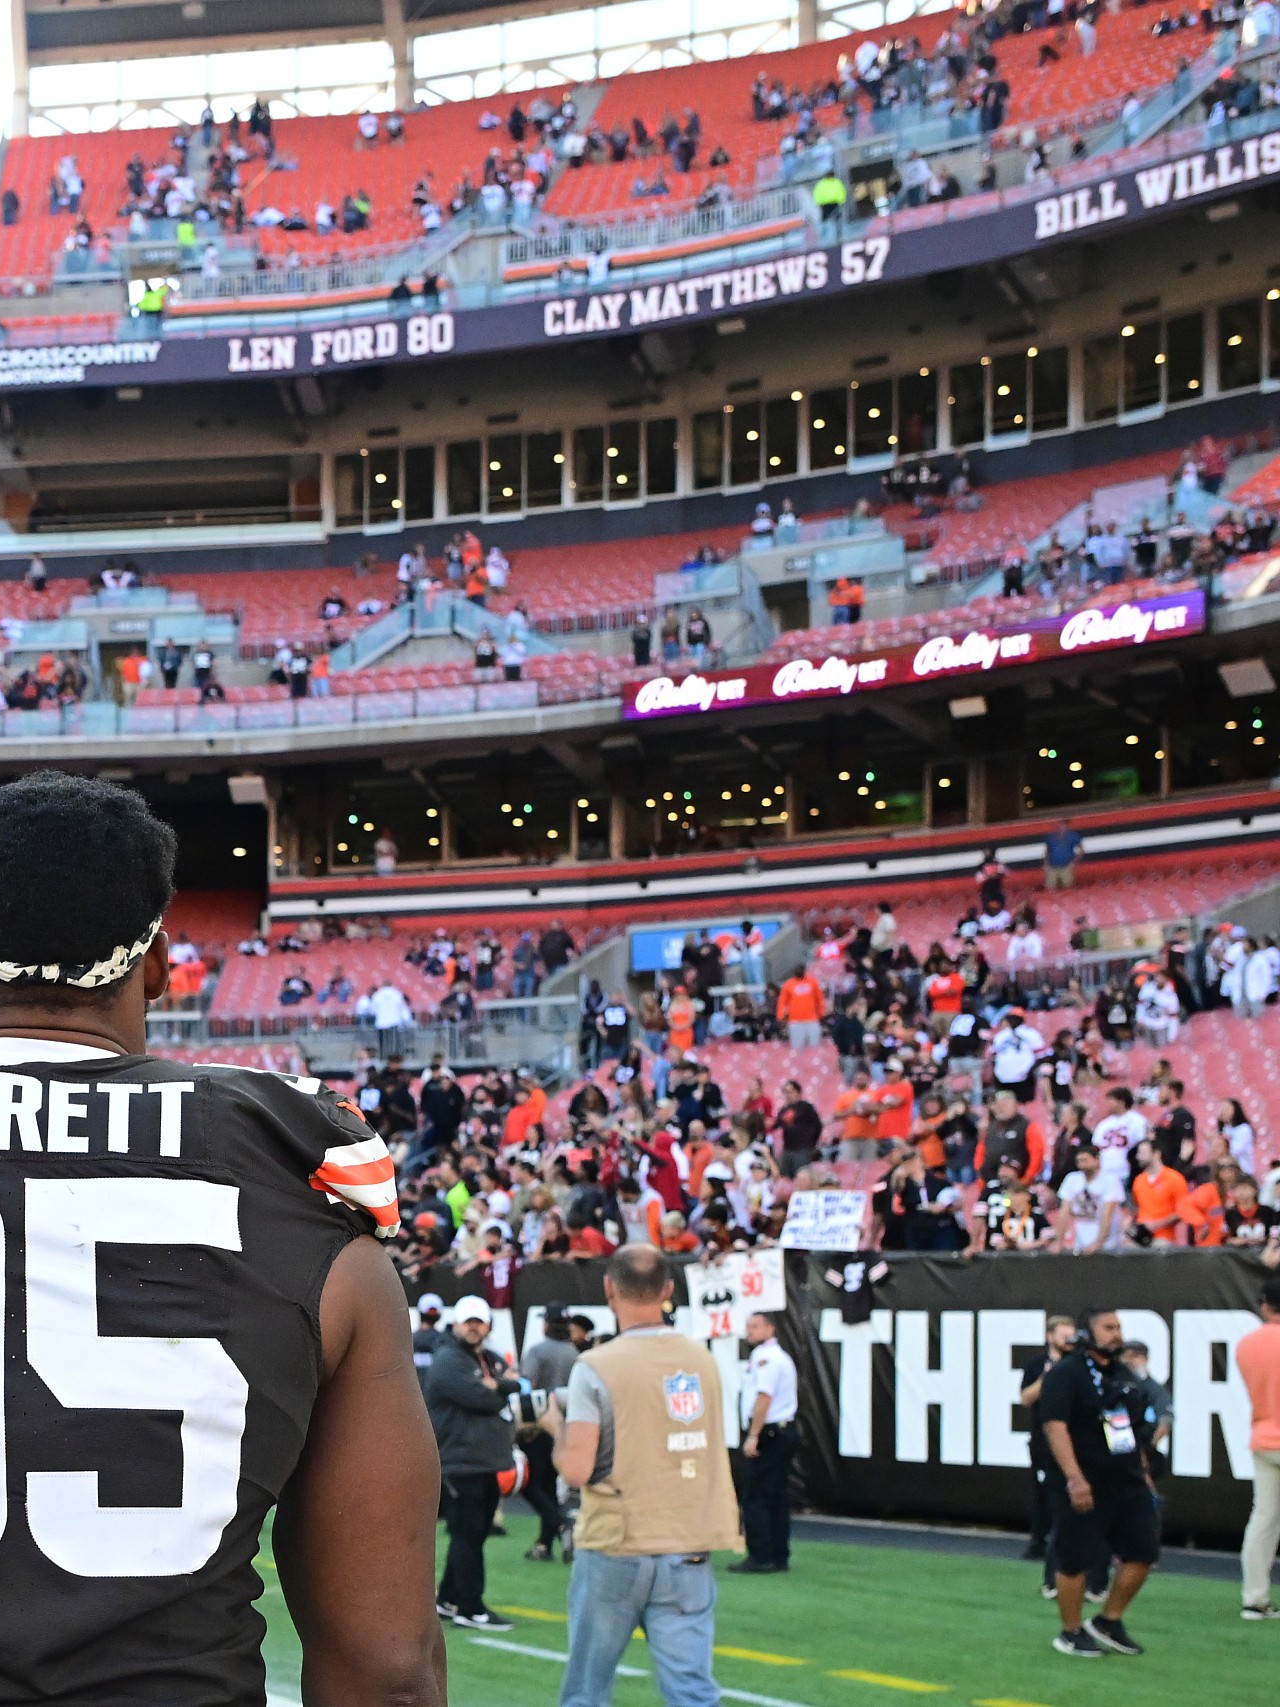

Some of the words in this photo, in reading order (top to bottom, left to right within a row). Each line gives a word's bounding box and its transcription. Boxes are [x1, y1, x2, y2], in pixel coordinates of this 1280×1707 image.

[1034, 180, 1128, 240] BILL
[1135, 131, 1280, 209] WILLIS
[543, 292, 628, 337] CLAY
[629, 252, 829, 326] MATTHEWS
[840, 236, 891, 286] 57
[228, 335, 297, 372] LEN
[311, 322, 399, 367] FORD
[406, 313, 455, 356] 80
[819, 1308, 1047, 1469] THE
